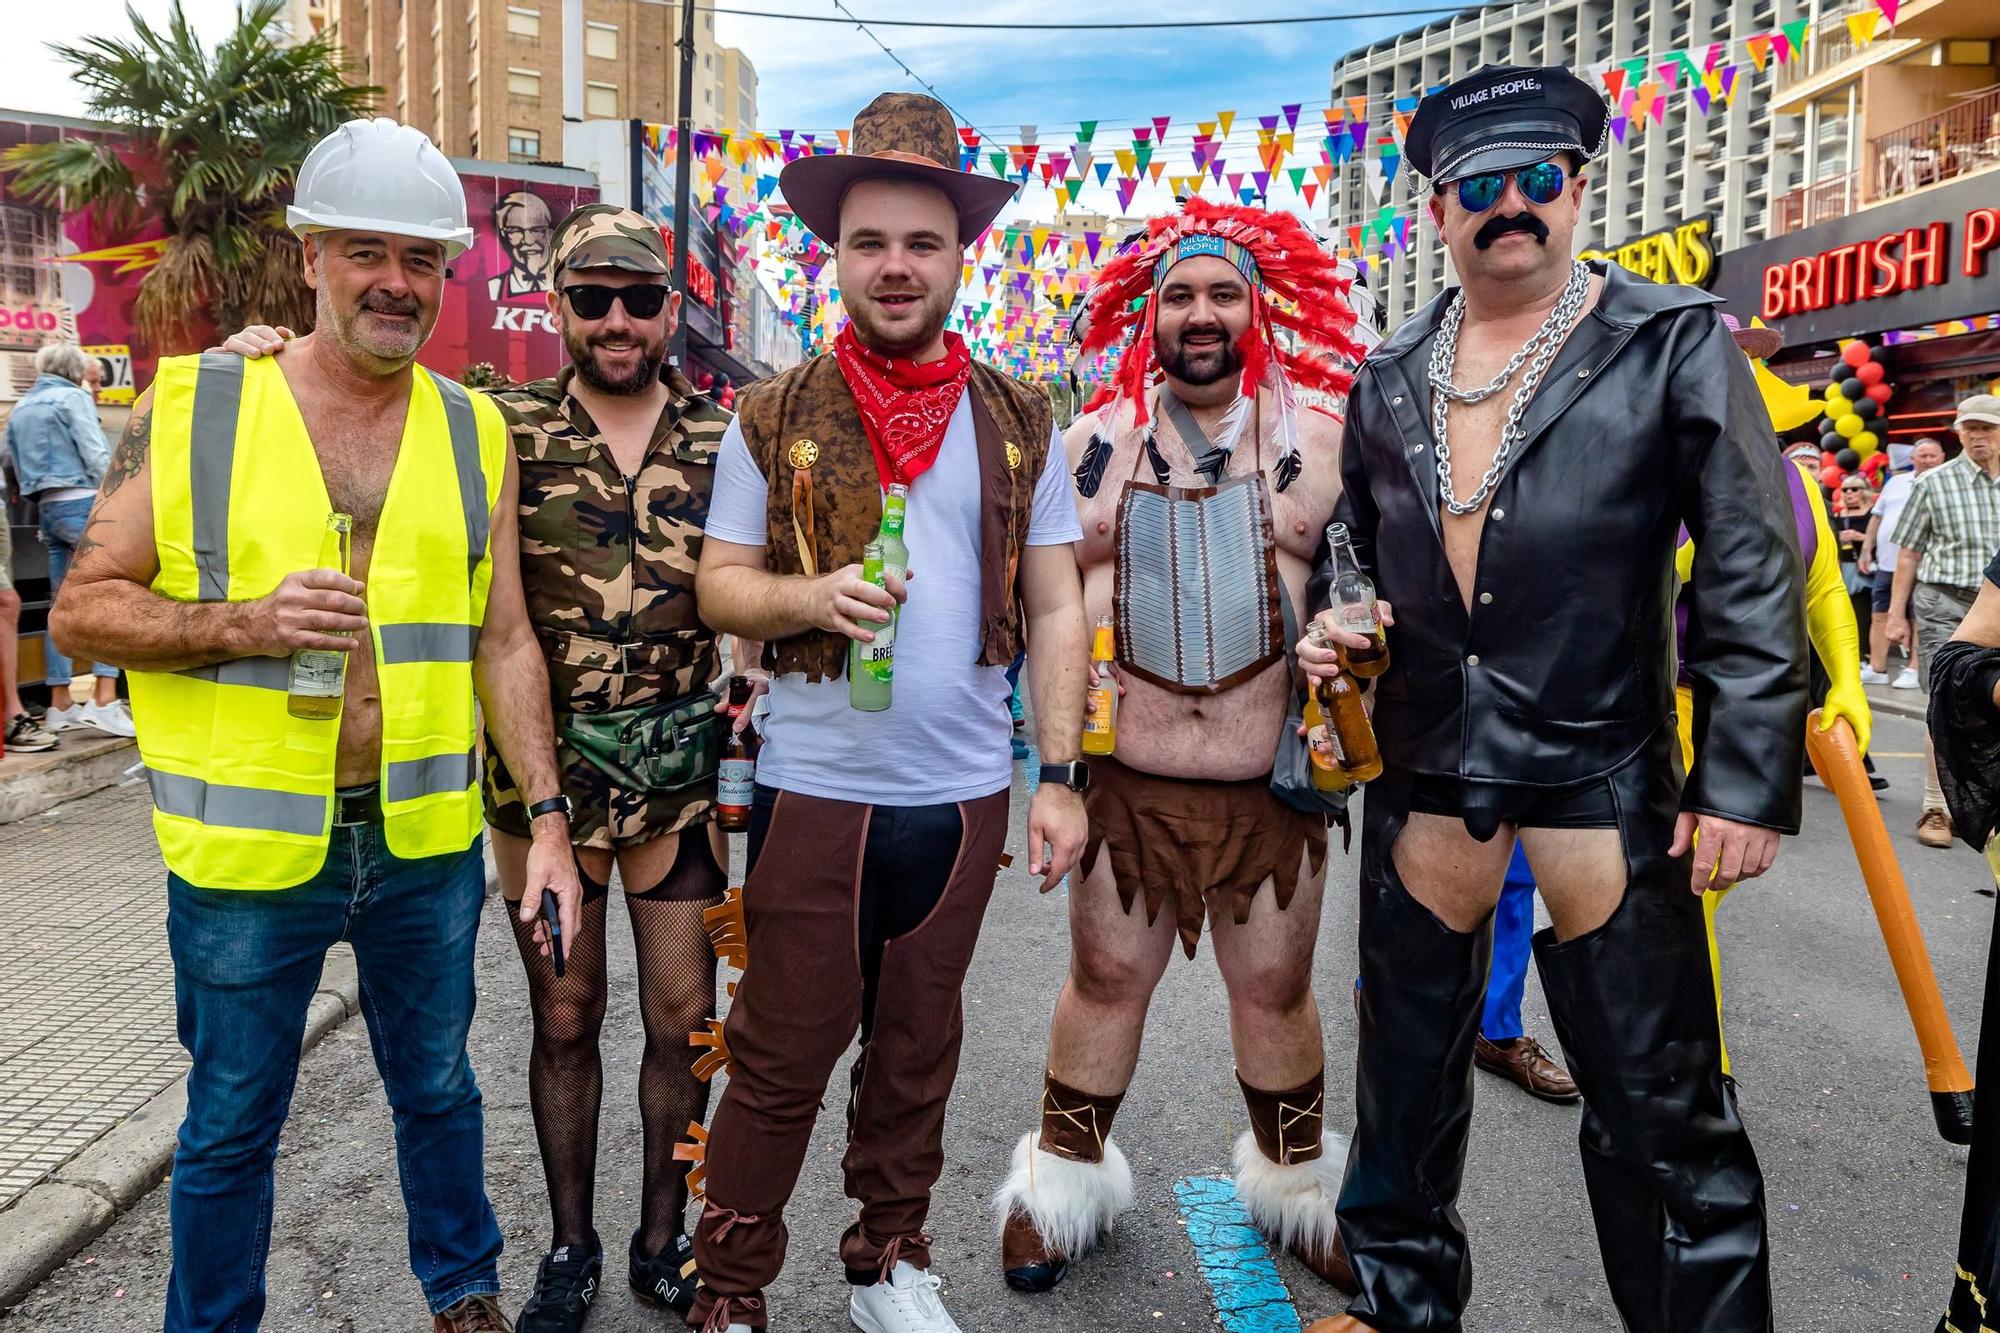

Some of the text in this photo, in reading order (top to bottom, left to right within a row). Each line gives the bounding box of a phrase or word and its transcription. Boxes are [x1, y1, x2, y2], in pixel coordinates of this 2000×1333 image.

[1451, 89, 1488, 110] VILLAGE
[1180, 243, 1219, 255] PEOPLE
[1181, 235, 1220, 246] VILLAGE
[1576, 220, 1709, 285] EENS
[1762, 222, 1946, 319] BRITISH
